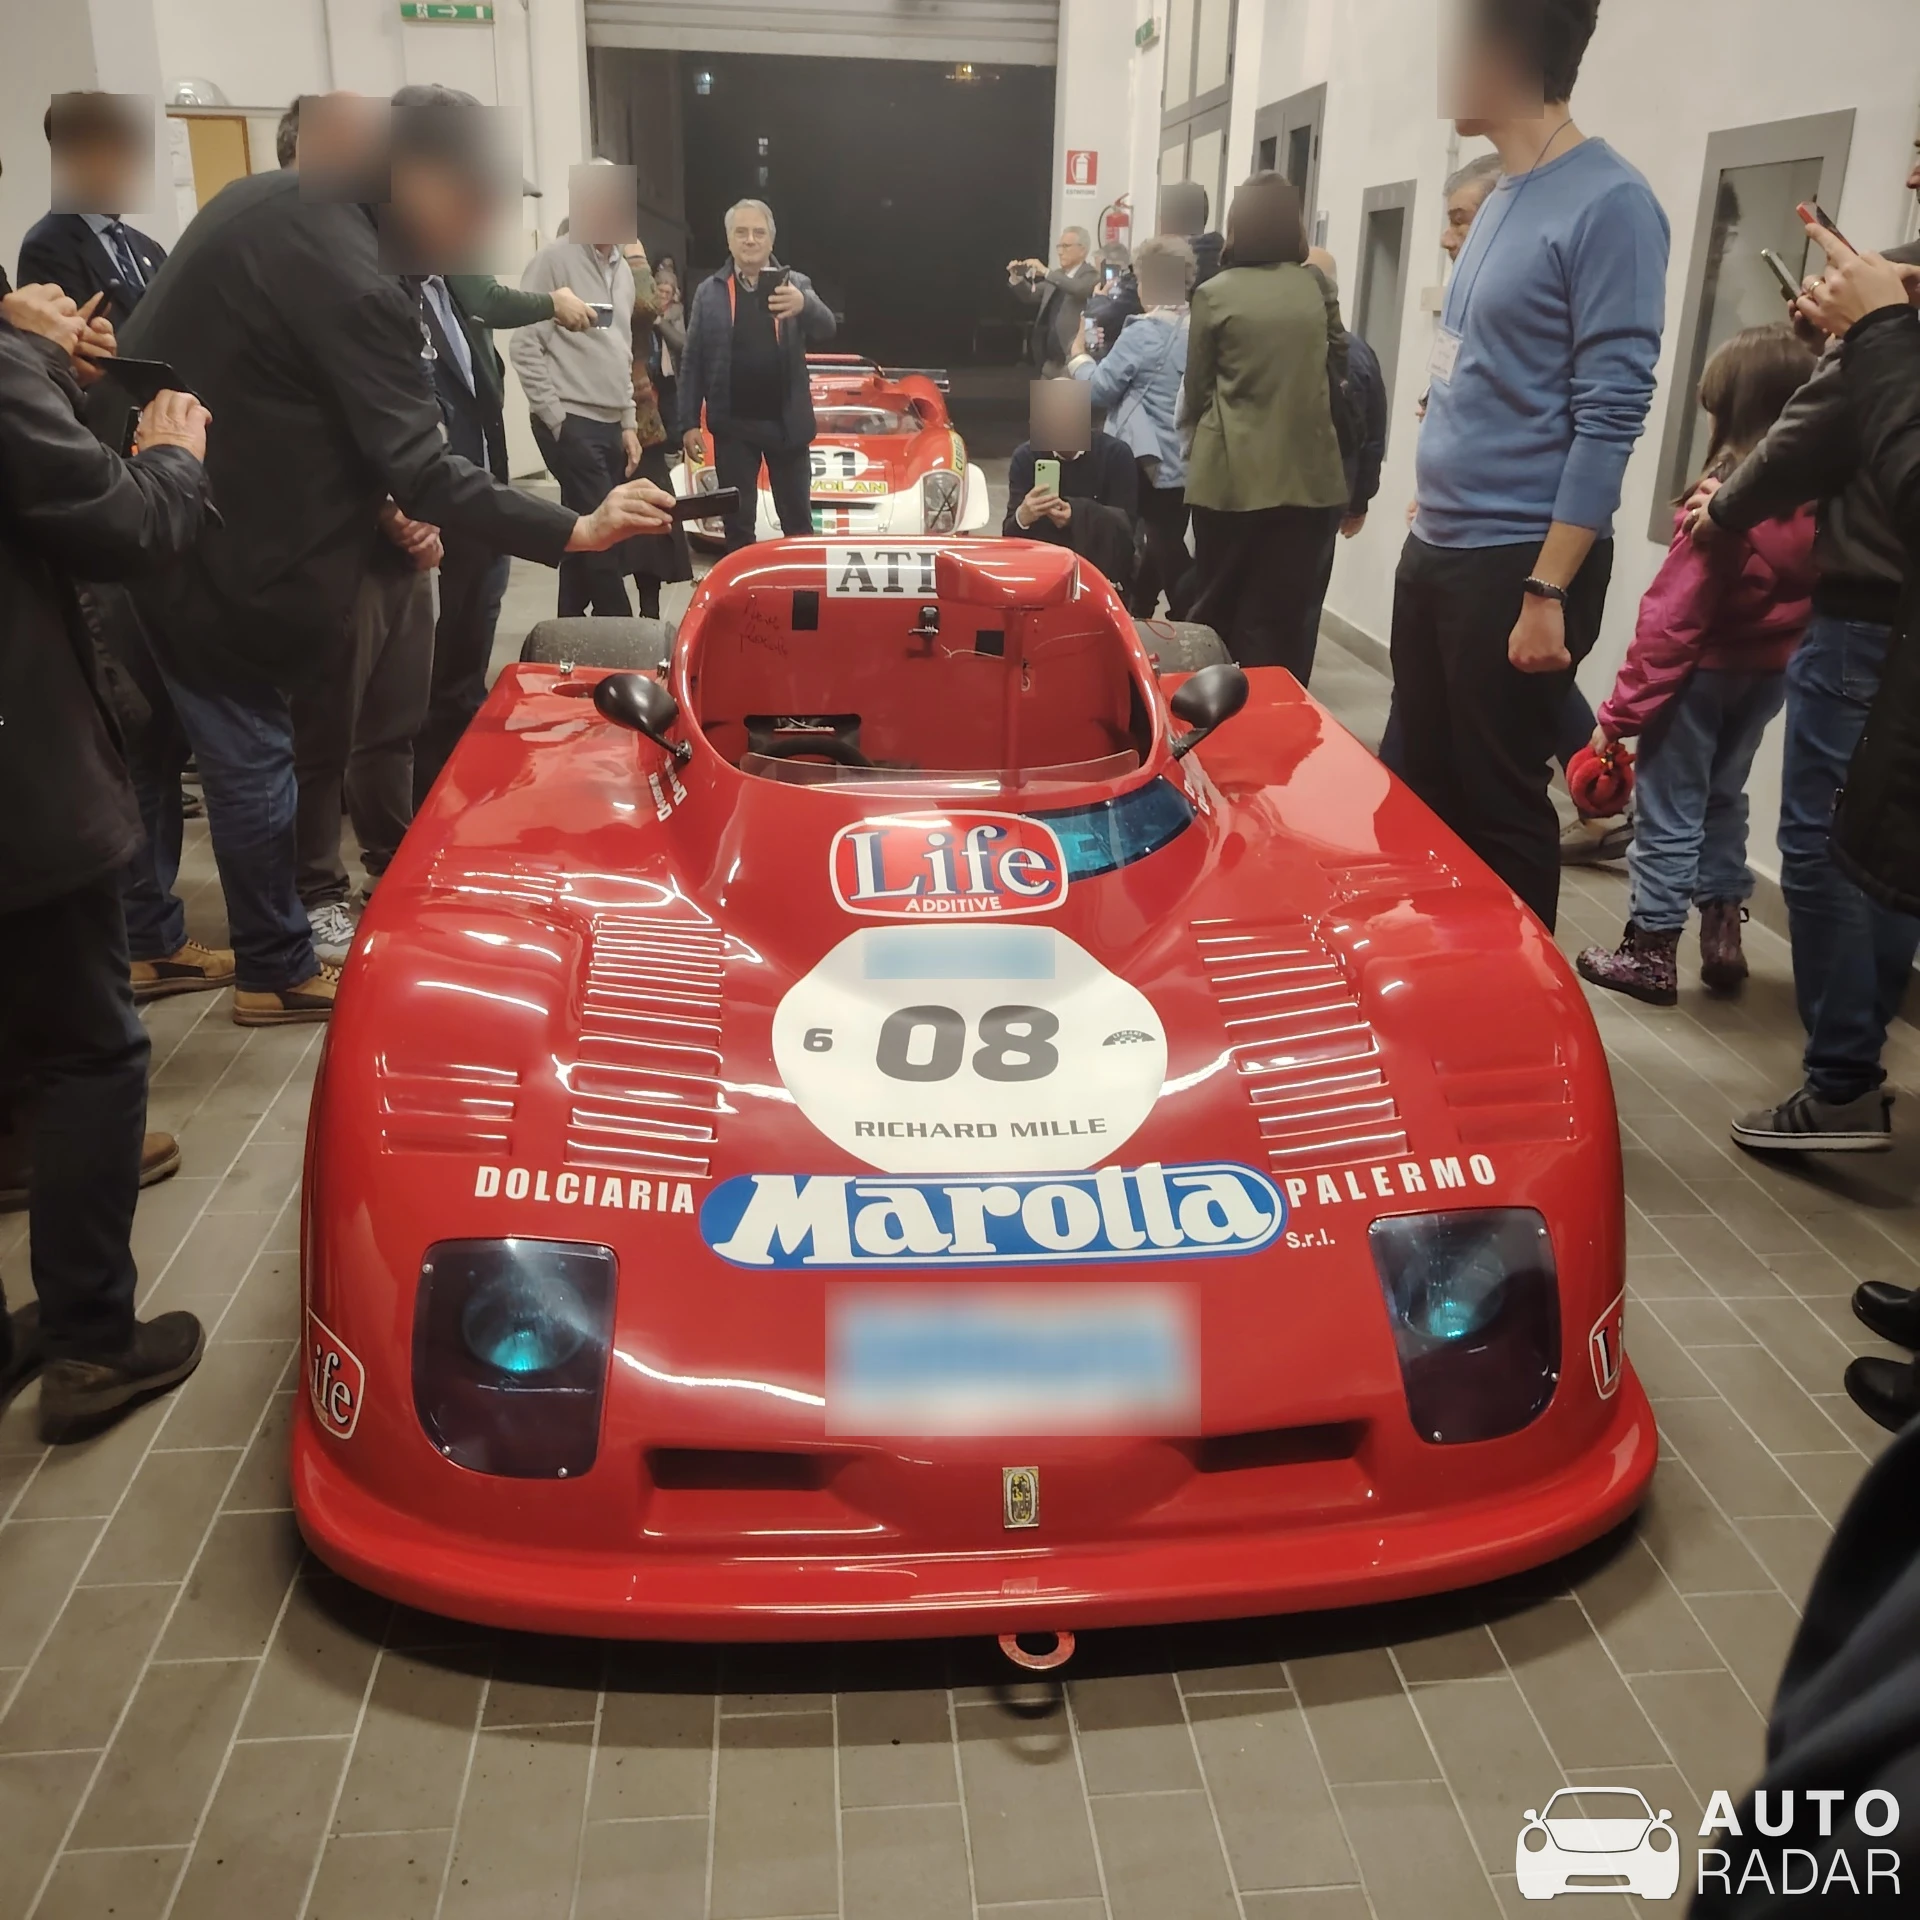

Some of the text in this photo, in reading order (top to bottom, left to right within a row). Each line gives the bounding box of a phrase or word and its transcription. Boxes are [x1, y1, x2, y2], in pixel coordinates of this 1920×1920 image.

[845, 825, 1056, 900] Life
[904, 895, 1002, 913] ADDITIVE
[803, 1027, 834, 1053] 6
[876, 1004, 1060, 1083] 08
[854, 1118, 1108, 1139] RICHARD MILLE
[474, 1165, 695, 1214] DOLCIARIA
[1284, 1153, 1497, 1208] PALERMO
[313, 1343, 353, 1425] ife
